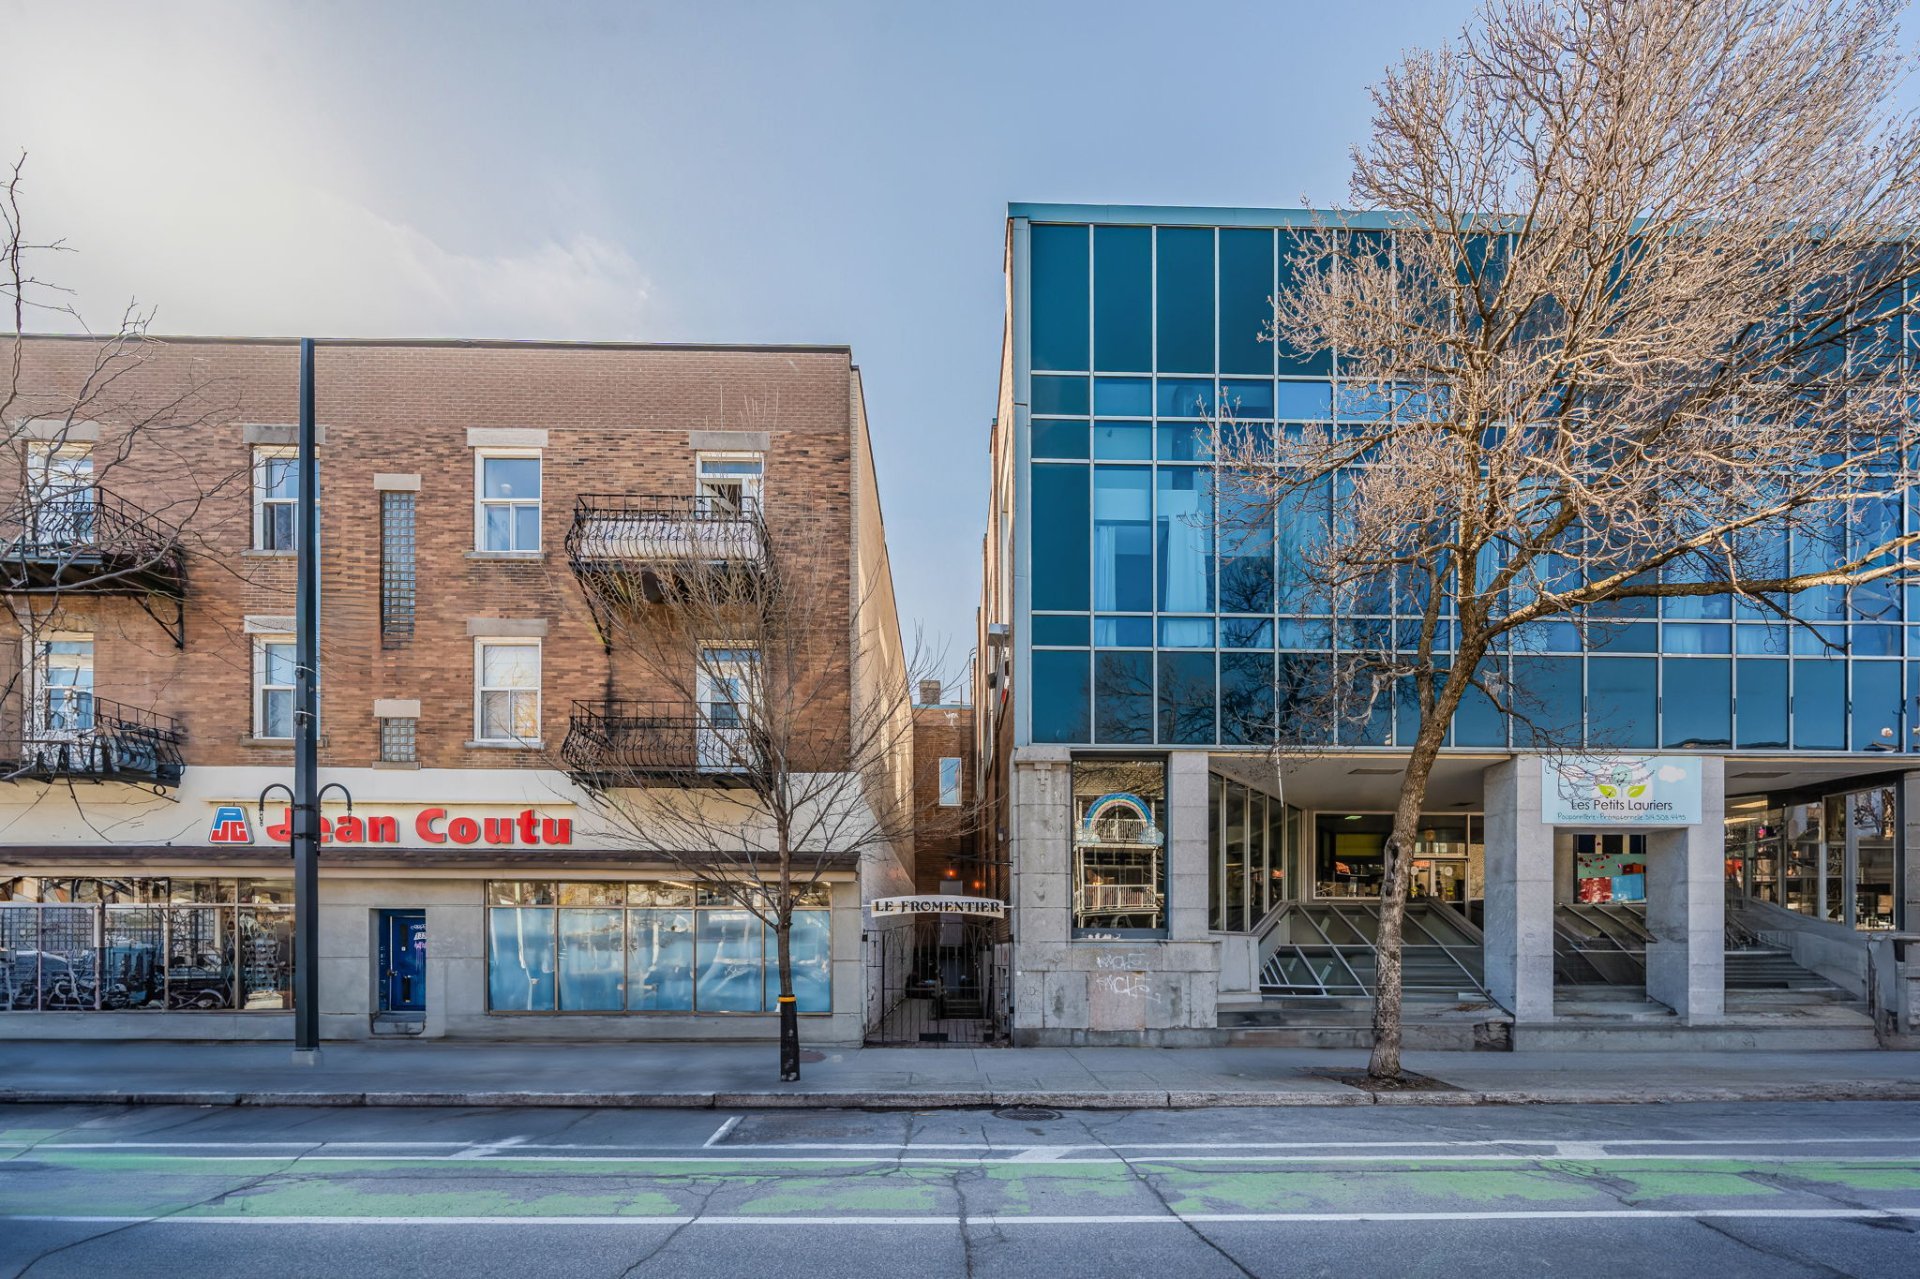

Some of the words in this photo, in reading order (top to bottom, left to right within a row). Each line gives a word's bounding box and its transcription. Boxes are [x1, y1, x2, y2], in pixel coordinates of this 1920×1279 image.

[1571, 799, 1590, 811] Les
[1593, 799, 1625, 811] Petits
[1628, 799, 1673, 811] Lauriers
[415, 807, 573, 845] Coutu
[874, 900, 894, 912] LE
[901, 900, 1001, 913] FROMENTIER
